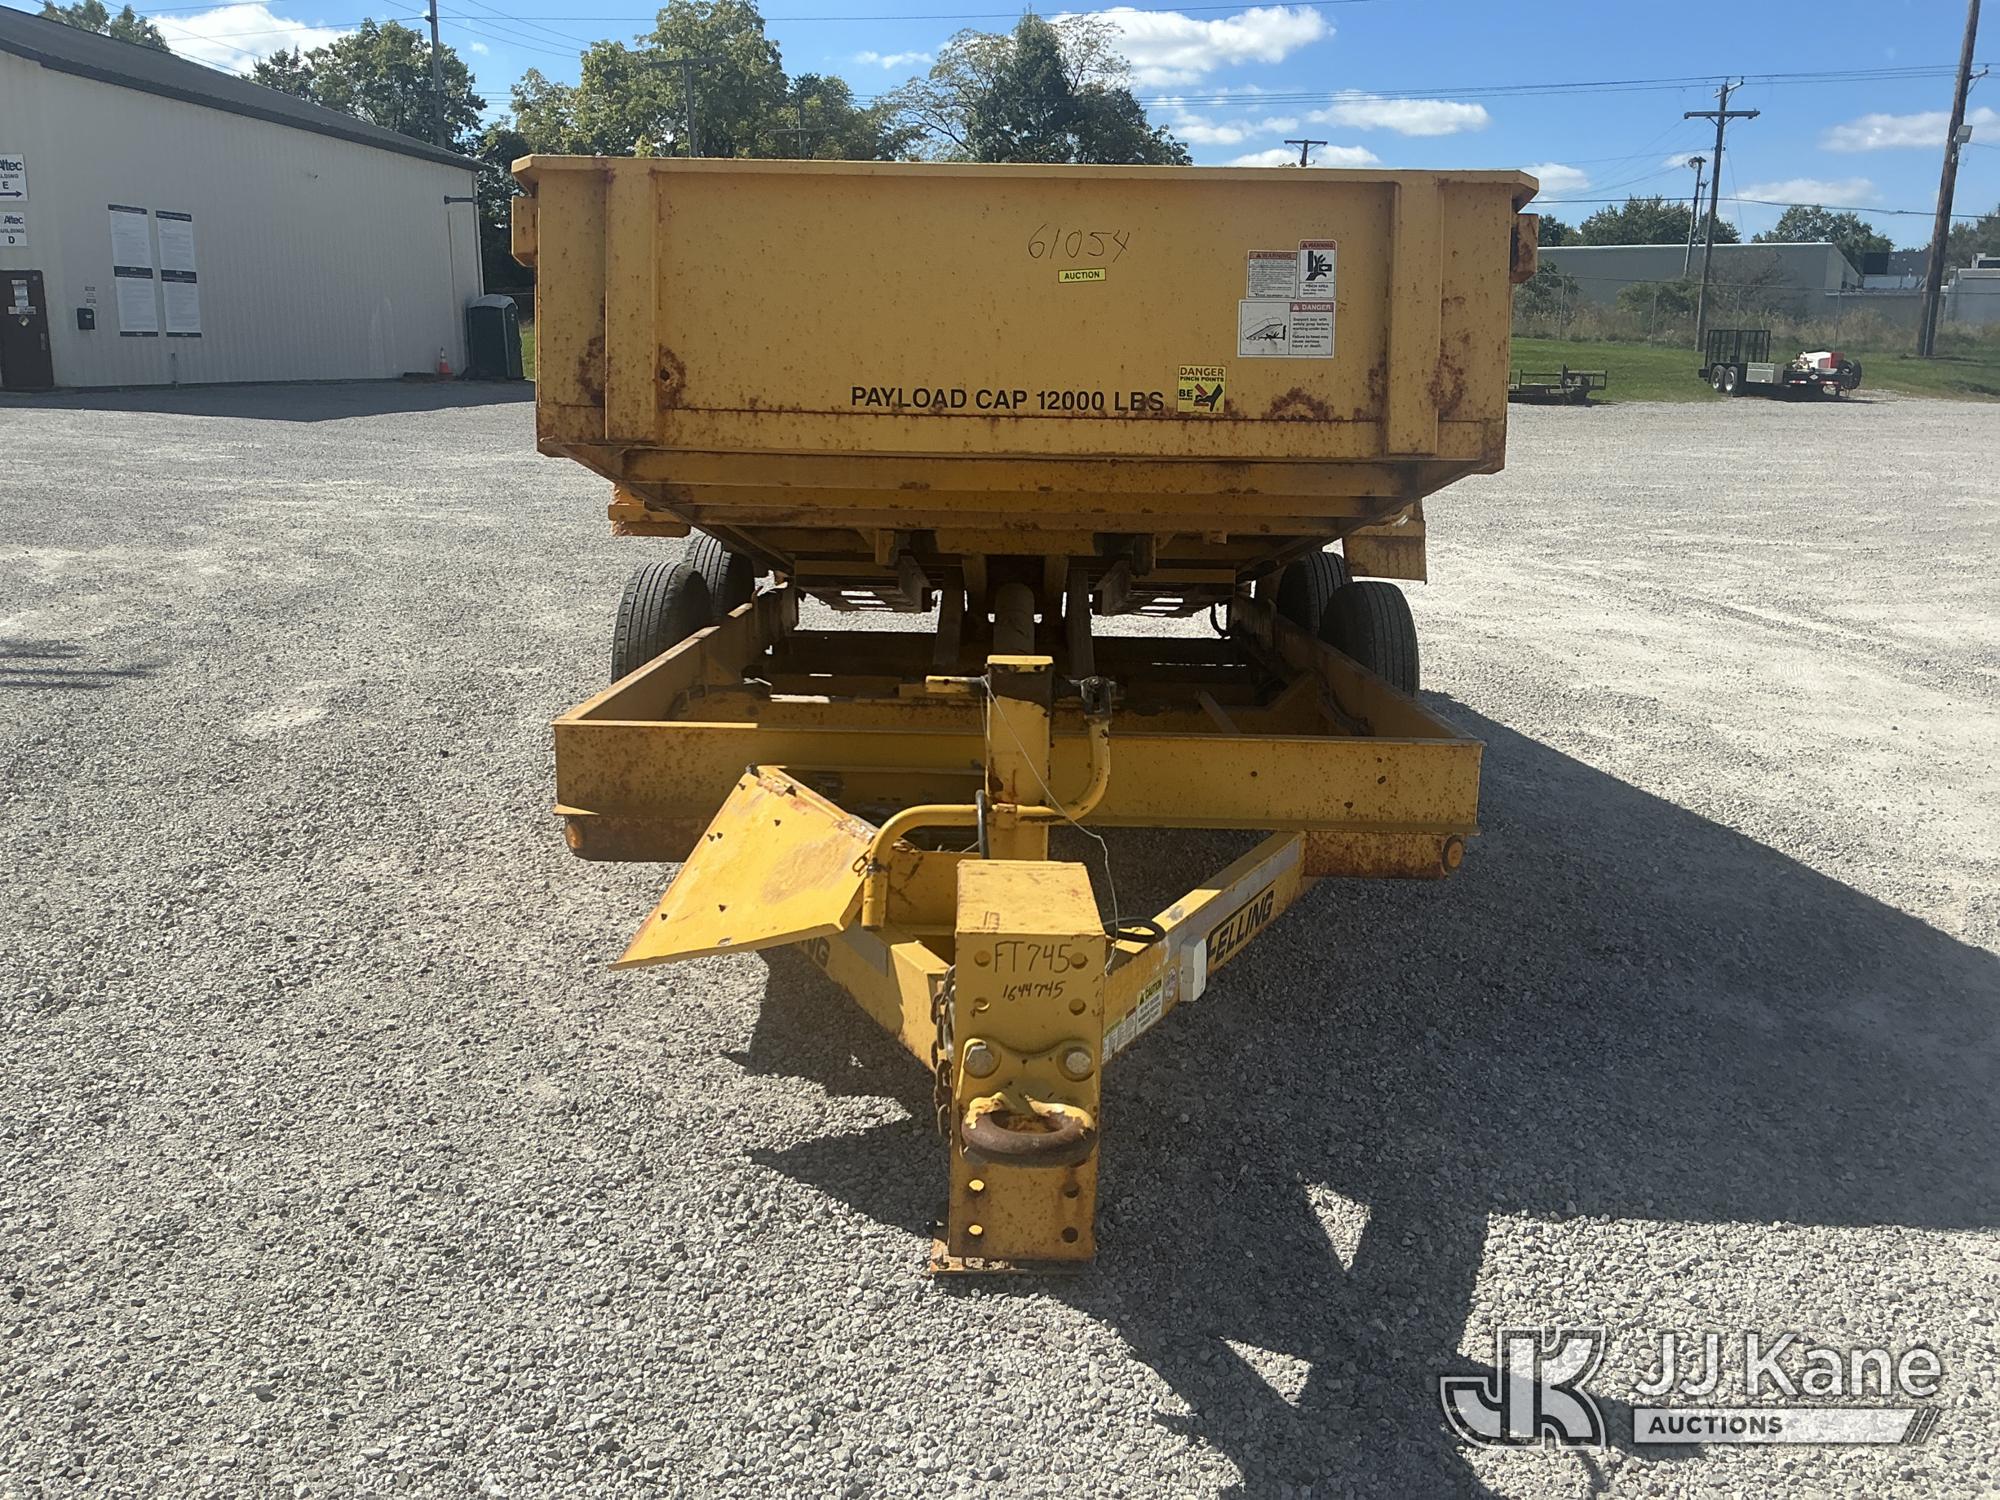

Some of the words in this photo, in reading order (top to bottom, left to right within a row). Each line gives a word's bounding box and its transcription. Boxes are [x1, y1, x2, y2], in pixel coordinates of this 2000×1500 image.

[2, 181, 9, 190] E
[4, 216, 23, 224] Altec
[8, 236, 15, 244] D
[1064, 271, 1100, 280] AUCTION
[1180, 367, 1224, 376] DANGER
[1179, 389, 1193, 397] BE
[852, 386, 967, 409] PAYLOAD
[976, 389, 1028, 409] CAP
[1038, 390, 1105, 411] 12000
[1114, 391, 1164, 411] LBS
[1206, 880, 1276, 964] FELLING
[1003, 980, 1066, 1001] 1644745
